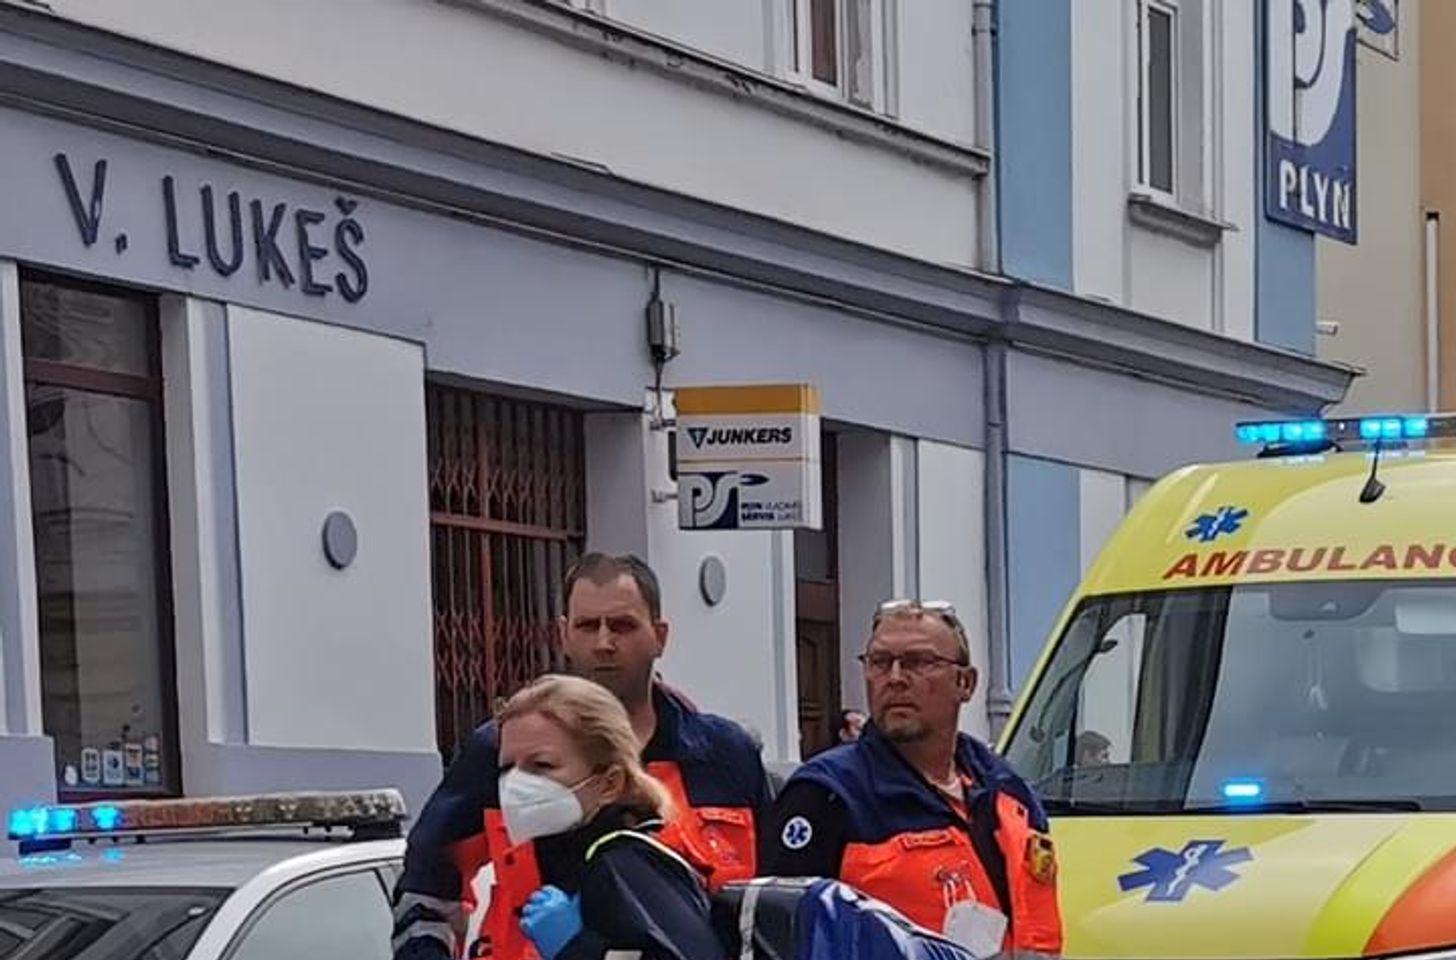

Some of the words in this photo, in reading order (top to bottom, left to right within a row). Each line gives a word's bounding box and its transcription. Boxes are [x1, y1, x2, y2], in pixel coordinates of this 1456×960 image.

[54, 152, 128, 254] V.
[162, 175, 369, 304] LUKEŠ
[1279, 158, 1350, 230] PLYN
[706, 427, 793, 445] JUNKERS
